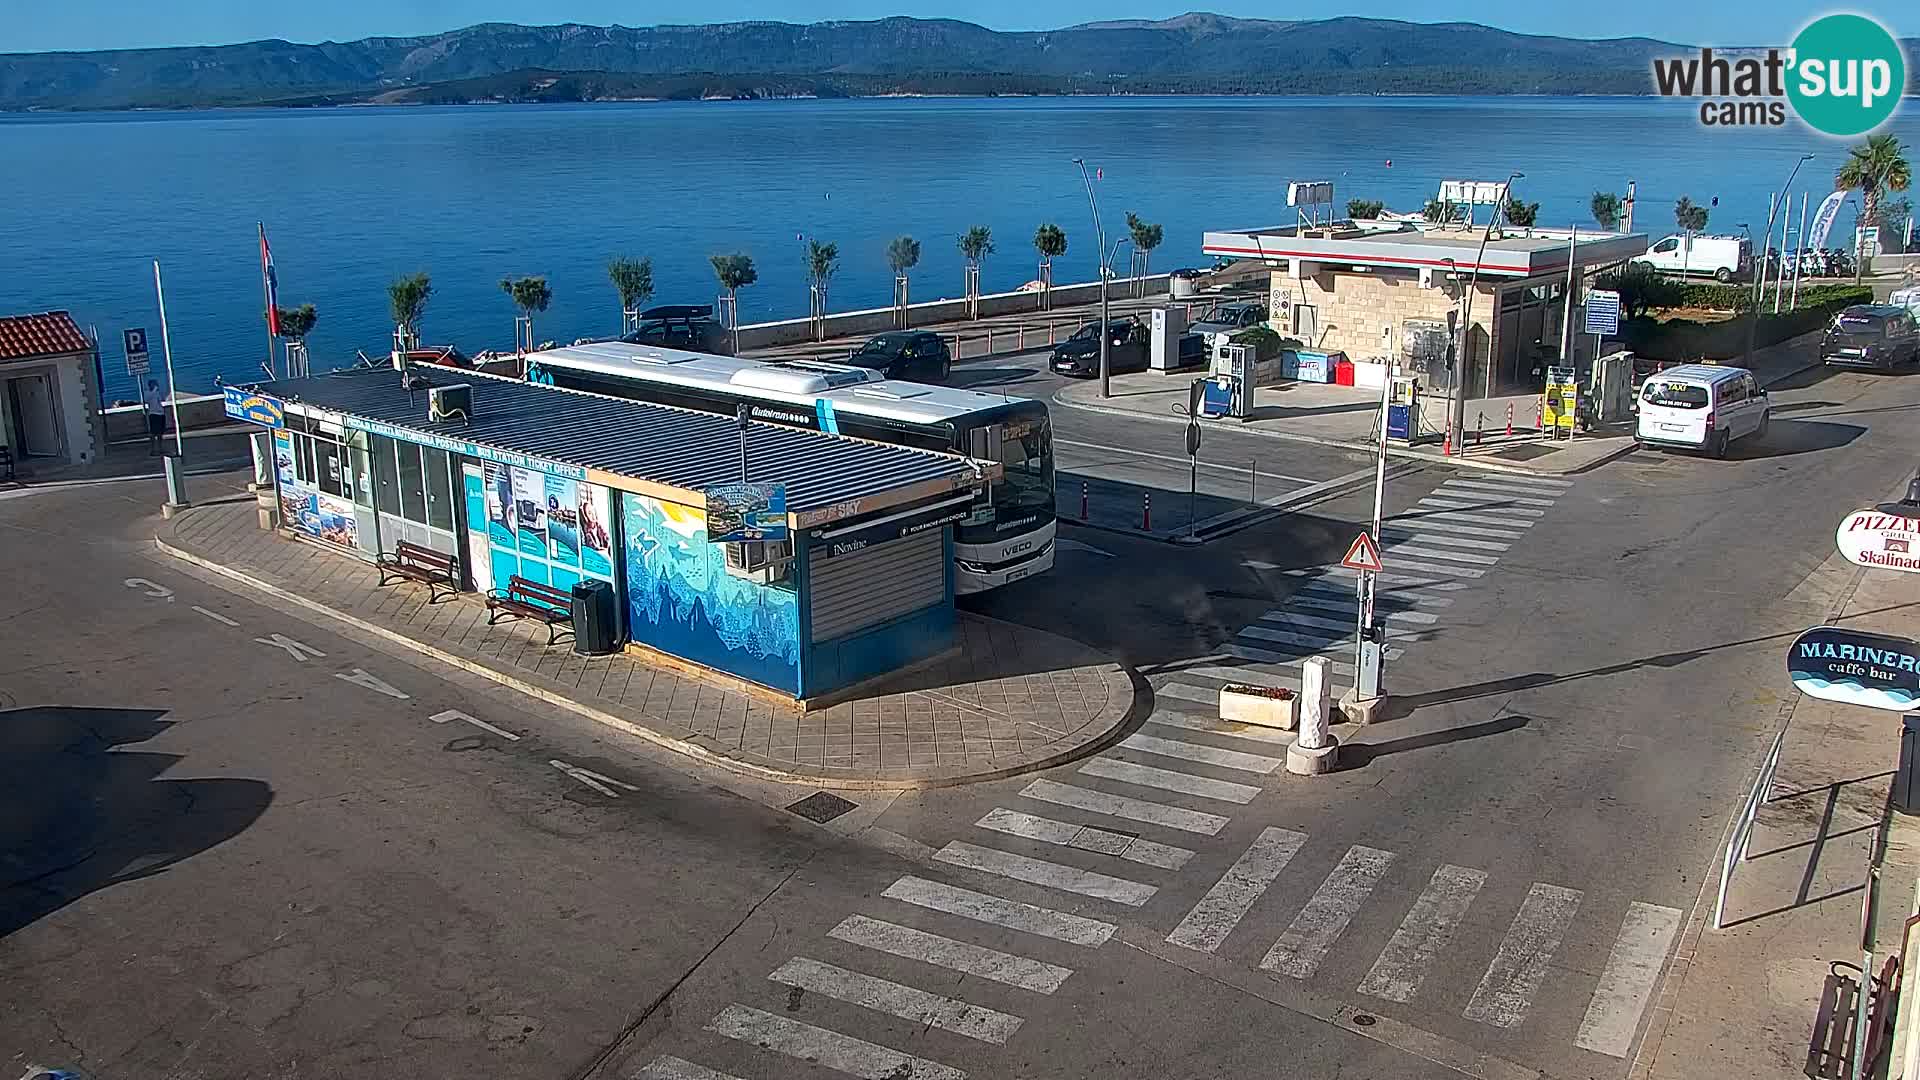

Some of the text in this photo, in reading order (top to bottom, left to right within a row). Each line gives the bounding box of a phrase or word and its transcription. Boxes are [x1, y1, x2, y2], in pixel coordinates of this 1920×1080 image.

[1667, 383, 1687, 392] TAXI
[492, 450, 526, 466] STATION
[527, 457, 554, 472] TICKET
[554, 462, 582, 478] OFFICE
[1848, 515, 1920, 533] PIZZE
[1881, 531, 1917, 540] GRILL
[1002, 541, 1032, 557] IVECO
[1828, 662, 1897, 681] caffe bar
